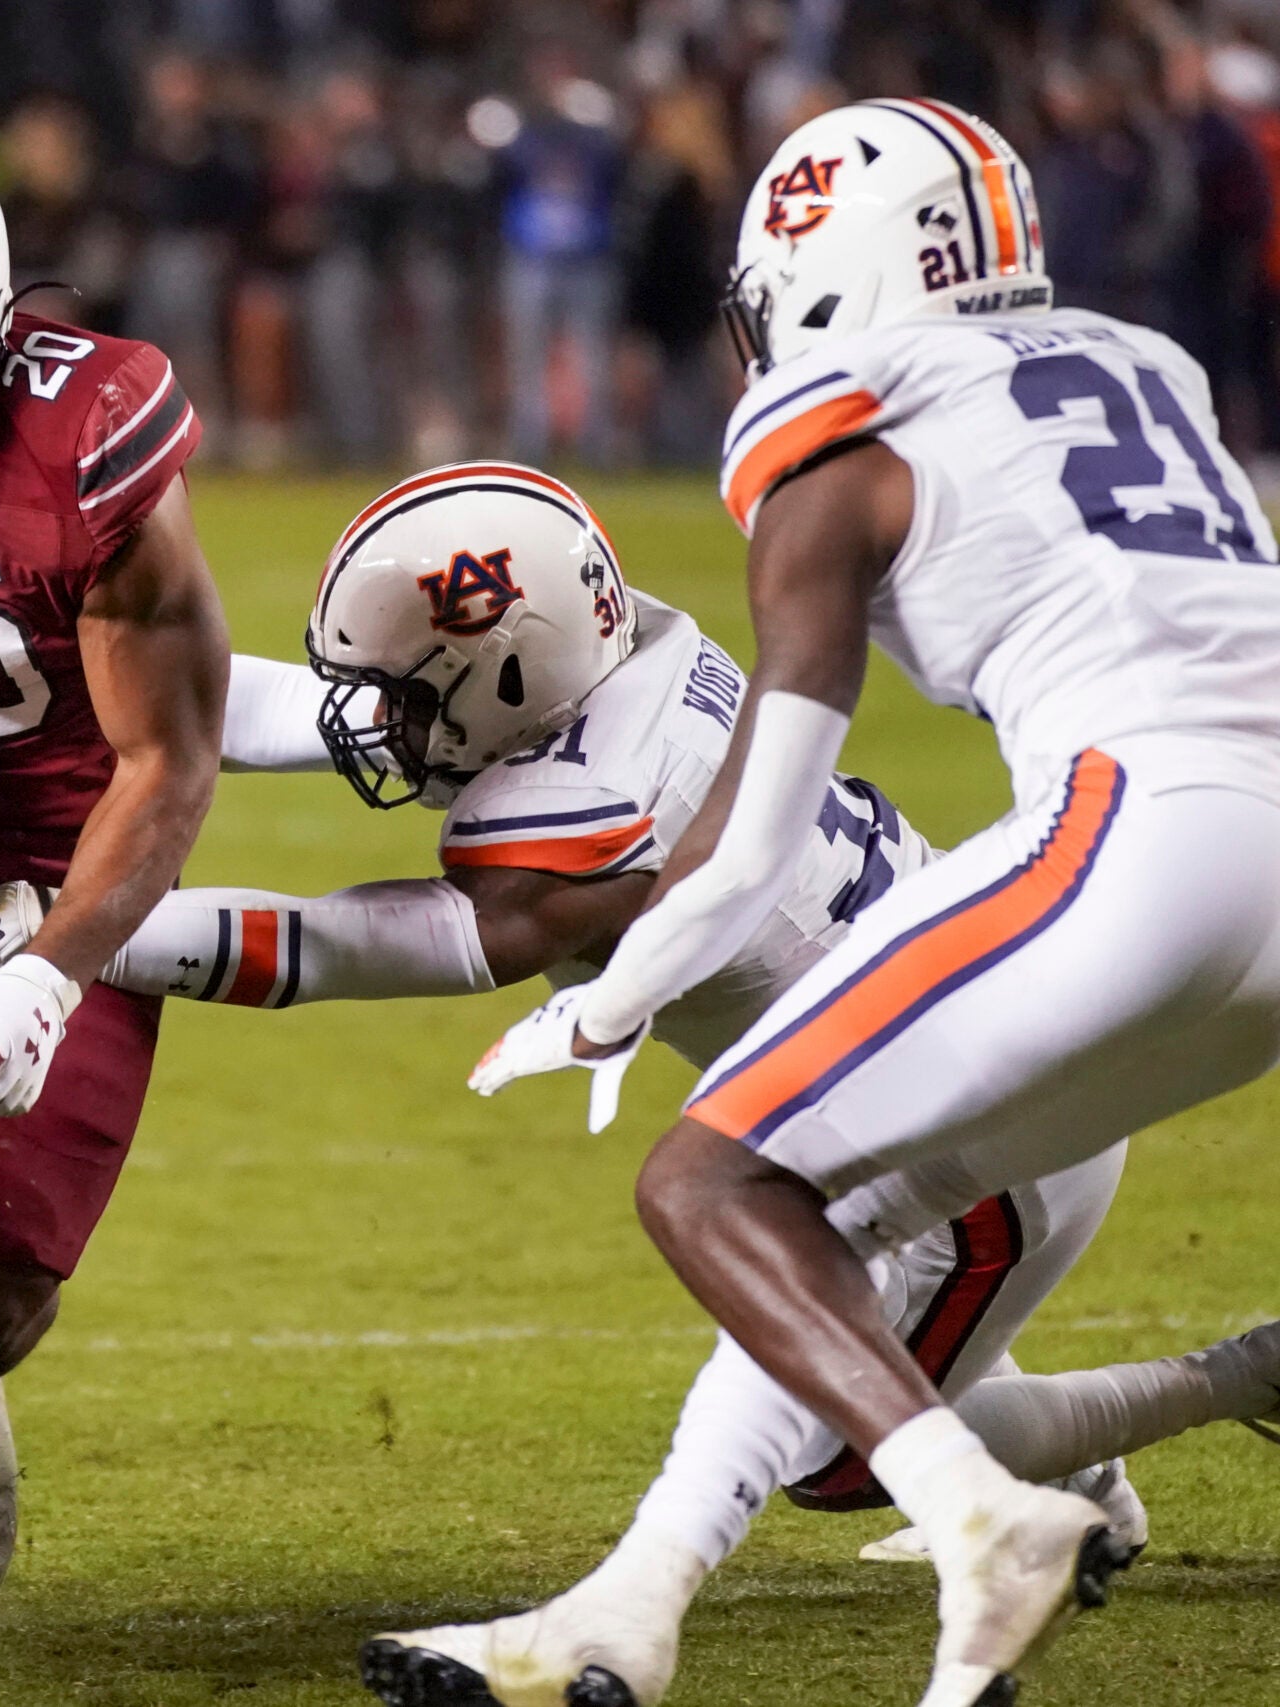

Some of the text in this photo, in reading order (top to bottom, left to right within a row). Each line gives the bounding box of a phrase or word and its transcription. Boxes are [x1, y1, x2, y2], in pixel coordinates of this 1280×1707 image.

[918, 240, 970, 293] 21
[2, 331, 97, 402] 20
[1009, 354, 1279, 566] 21
[594, 585, 623, 639] 31
